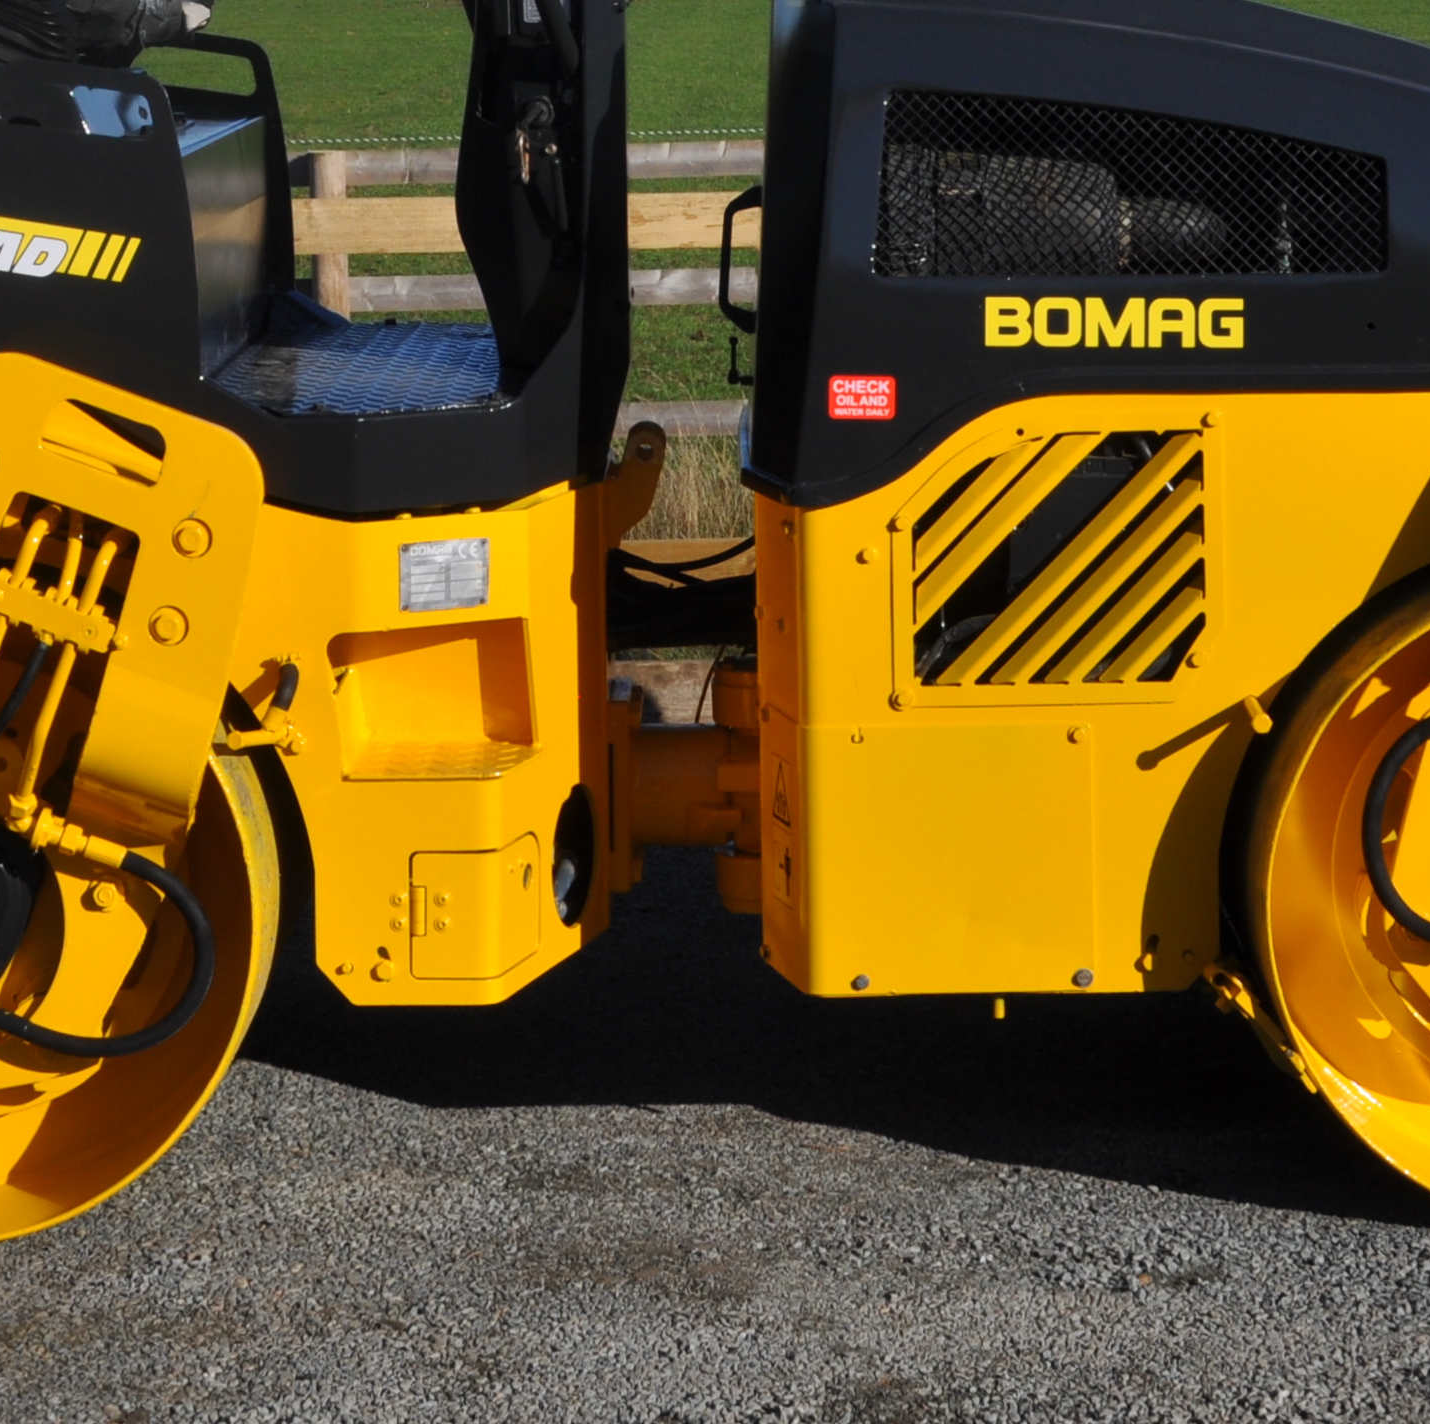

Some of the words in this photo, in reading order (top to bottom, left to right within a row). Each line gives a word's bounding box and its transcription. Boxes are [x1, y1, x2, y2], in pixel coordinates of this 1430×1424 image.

[985, 296, 1244, 348] BOMAG
[832, 379, 890, 394] CHECK
[835, 394, 858, 406] OIL
[859, 395, 888, 407] AND
[834, 408, 864, 416] WATER
[865, 408, 890, 417] DAILY
